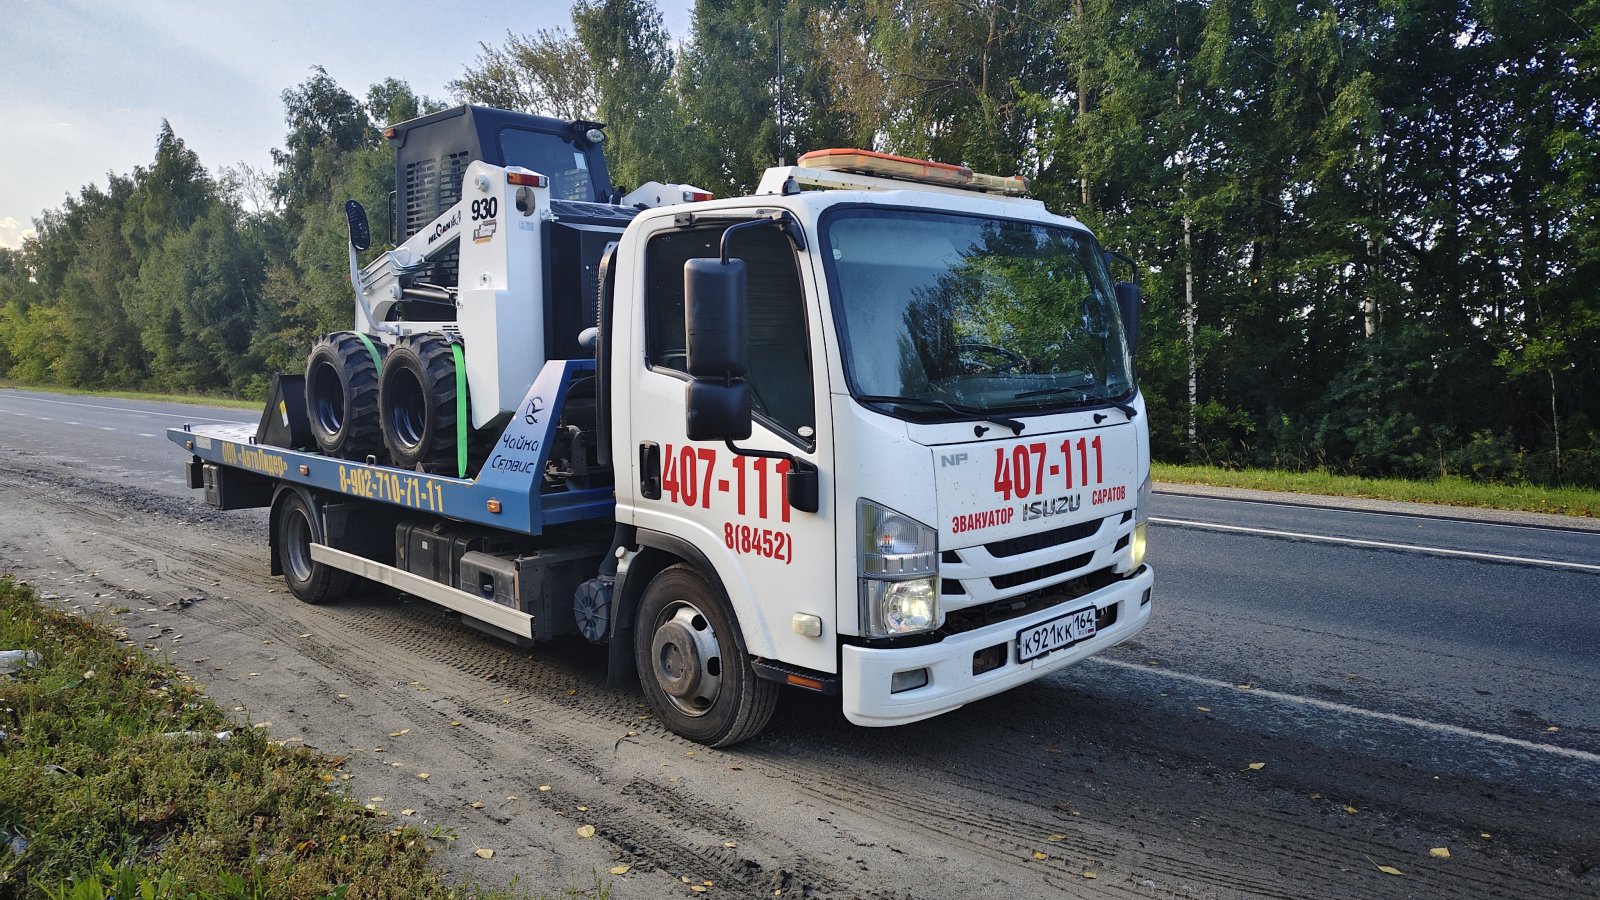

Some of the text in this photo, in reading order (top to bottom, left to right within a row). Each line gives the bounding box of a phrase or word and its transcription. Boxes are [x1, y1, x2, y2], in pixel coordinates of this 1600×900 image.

[472, 197, 498, 221] 930
[221, 442, 238, 465] ООО
[503, 434, 540, 452] Чайка
[491, 454, 535, 475] Сервис
[994, 435, 1103, 501] 407-111
[662, 443, 791, 523] 407-111
[1022, 493, 1081, 521] ISUZU
[1091, 485, 1126, 506] САРАТОВ
[952, 506, 1014, 534] ЭВАКУАТОР
[724, 522, 792, 565] 8(8452)
[1074, 611, 1094, 630] 164
